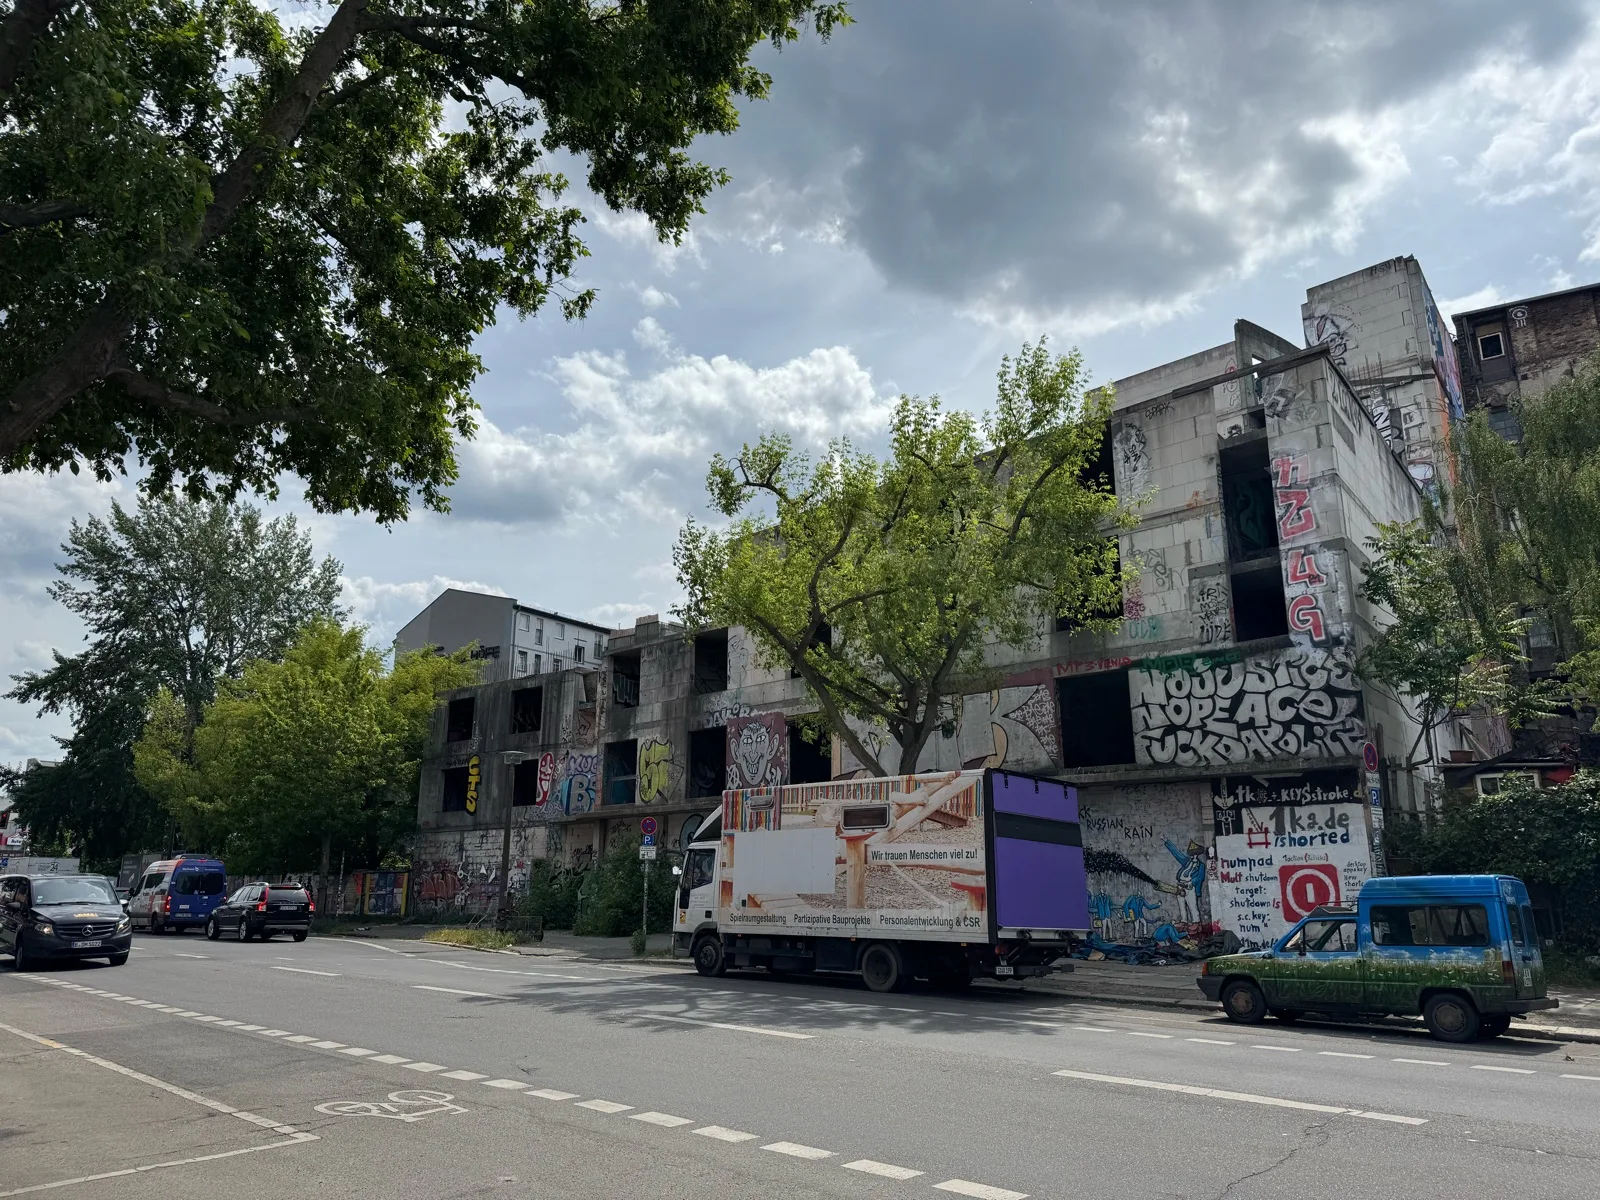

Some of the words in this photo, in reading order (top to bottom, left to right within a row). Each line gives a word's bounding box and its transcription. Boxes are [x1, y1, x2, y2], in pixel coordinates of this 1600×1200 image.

[644, 835, 651, 844] P
[871, 850, 883, 861] Wir
[884, 850, 907, 861] trauen
[909, 849, 947, 860] Menschen
[949, 848, 964, 860] viel
[966, 849, 978, 860] zu!
[729, 914, 787, 926] Spielraumgestaltung
[793, 914, 831, 925] Partizipative
[832, 915, 871, 927] Bauprojekte
[879, 915, 953, 929] Personalentwicklung
[955, 917, 963, 927] &
[964, 917, 981, 928] CSR
